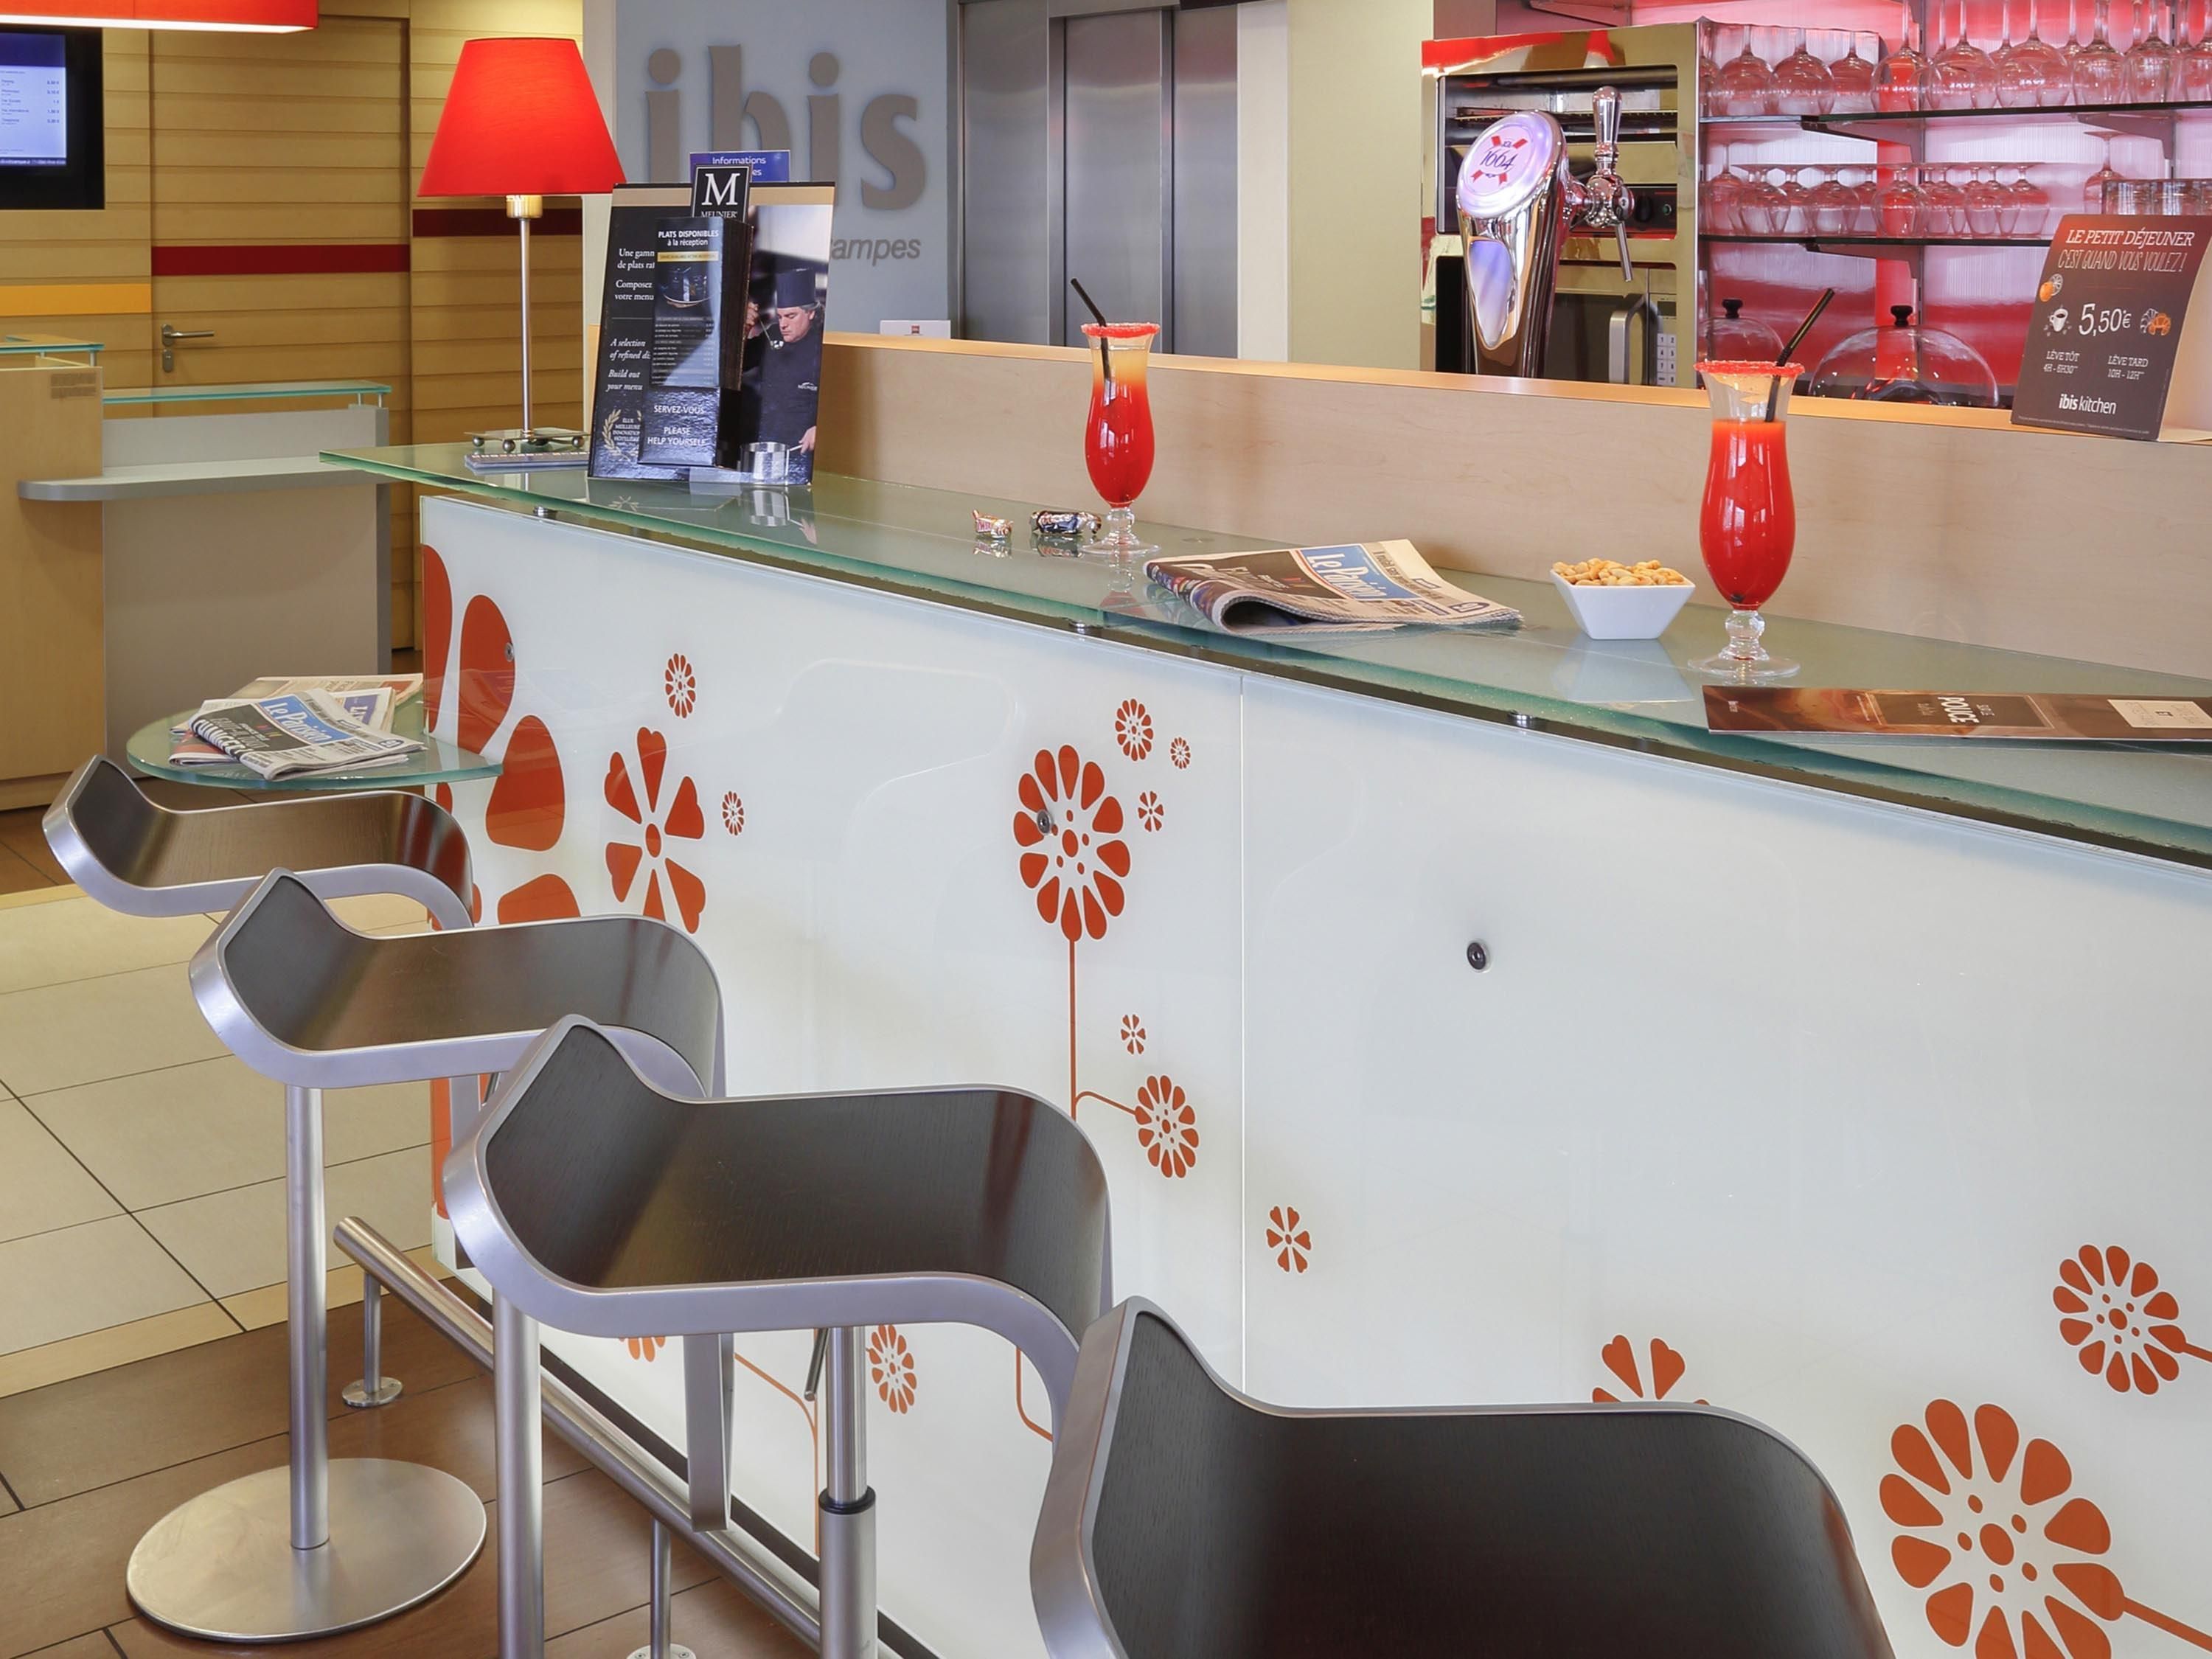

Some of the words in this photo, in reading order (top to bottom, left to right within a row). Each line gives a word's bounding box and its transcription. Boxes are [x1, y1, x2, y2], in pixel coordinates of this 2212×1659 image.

[645, 44, 926, 210] ibis
[712, 156, 767, 164] Informations
[1480, 149, 1518, 170] 1664
[701, 173, 740, 206] M
[679, 239, 708, 247] réception
[2066, 229, 2083, 244] LE
[2084, 231, 2124, 245] PETIT
[2123, 227, 2194, 249] DÉJEUNER
[619, 248, 633, 257] Une
[831, 238, 921, 266] ampes
[617, 260, 626, 268] de
[627, 260, 644, 271] plats
[2082, 251, 2118, 270] QUAND
[2118, 251, 2143, 271] VOUS
[2143, 251, 2183, 272] VOULEZ
[616, 279, 653, 291] Composez
[611, 338, 617, 347] A
[618, 338, 646, 347] selection
[610, 350, 618, 361] of
[618, 350, 641, 361] refined
[2128, 357, 2149, 367] TARD
[608, 369, 628, 378] Build
[606, 384, 622, 392] your
[653, 405, 705, 414] SERVEZ-VOUS
[2059, 394, 2079, 410] ibis
[2079, 396, 2117, 414] kitchen
[664, 427, 692, 435] PLEASE
[647, 437, 666, 445] HELP
[667, 438, 708, 446] YOURSELF
[1307, 554, 1345, 568] Le
[1317, 566, 1387, 597] Parisien
[264, 702, 288, 715] Le
[1937, 697, 1980, 723] POUCE
[274, 711, 332, 743] Parisien
